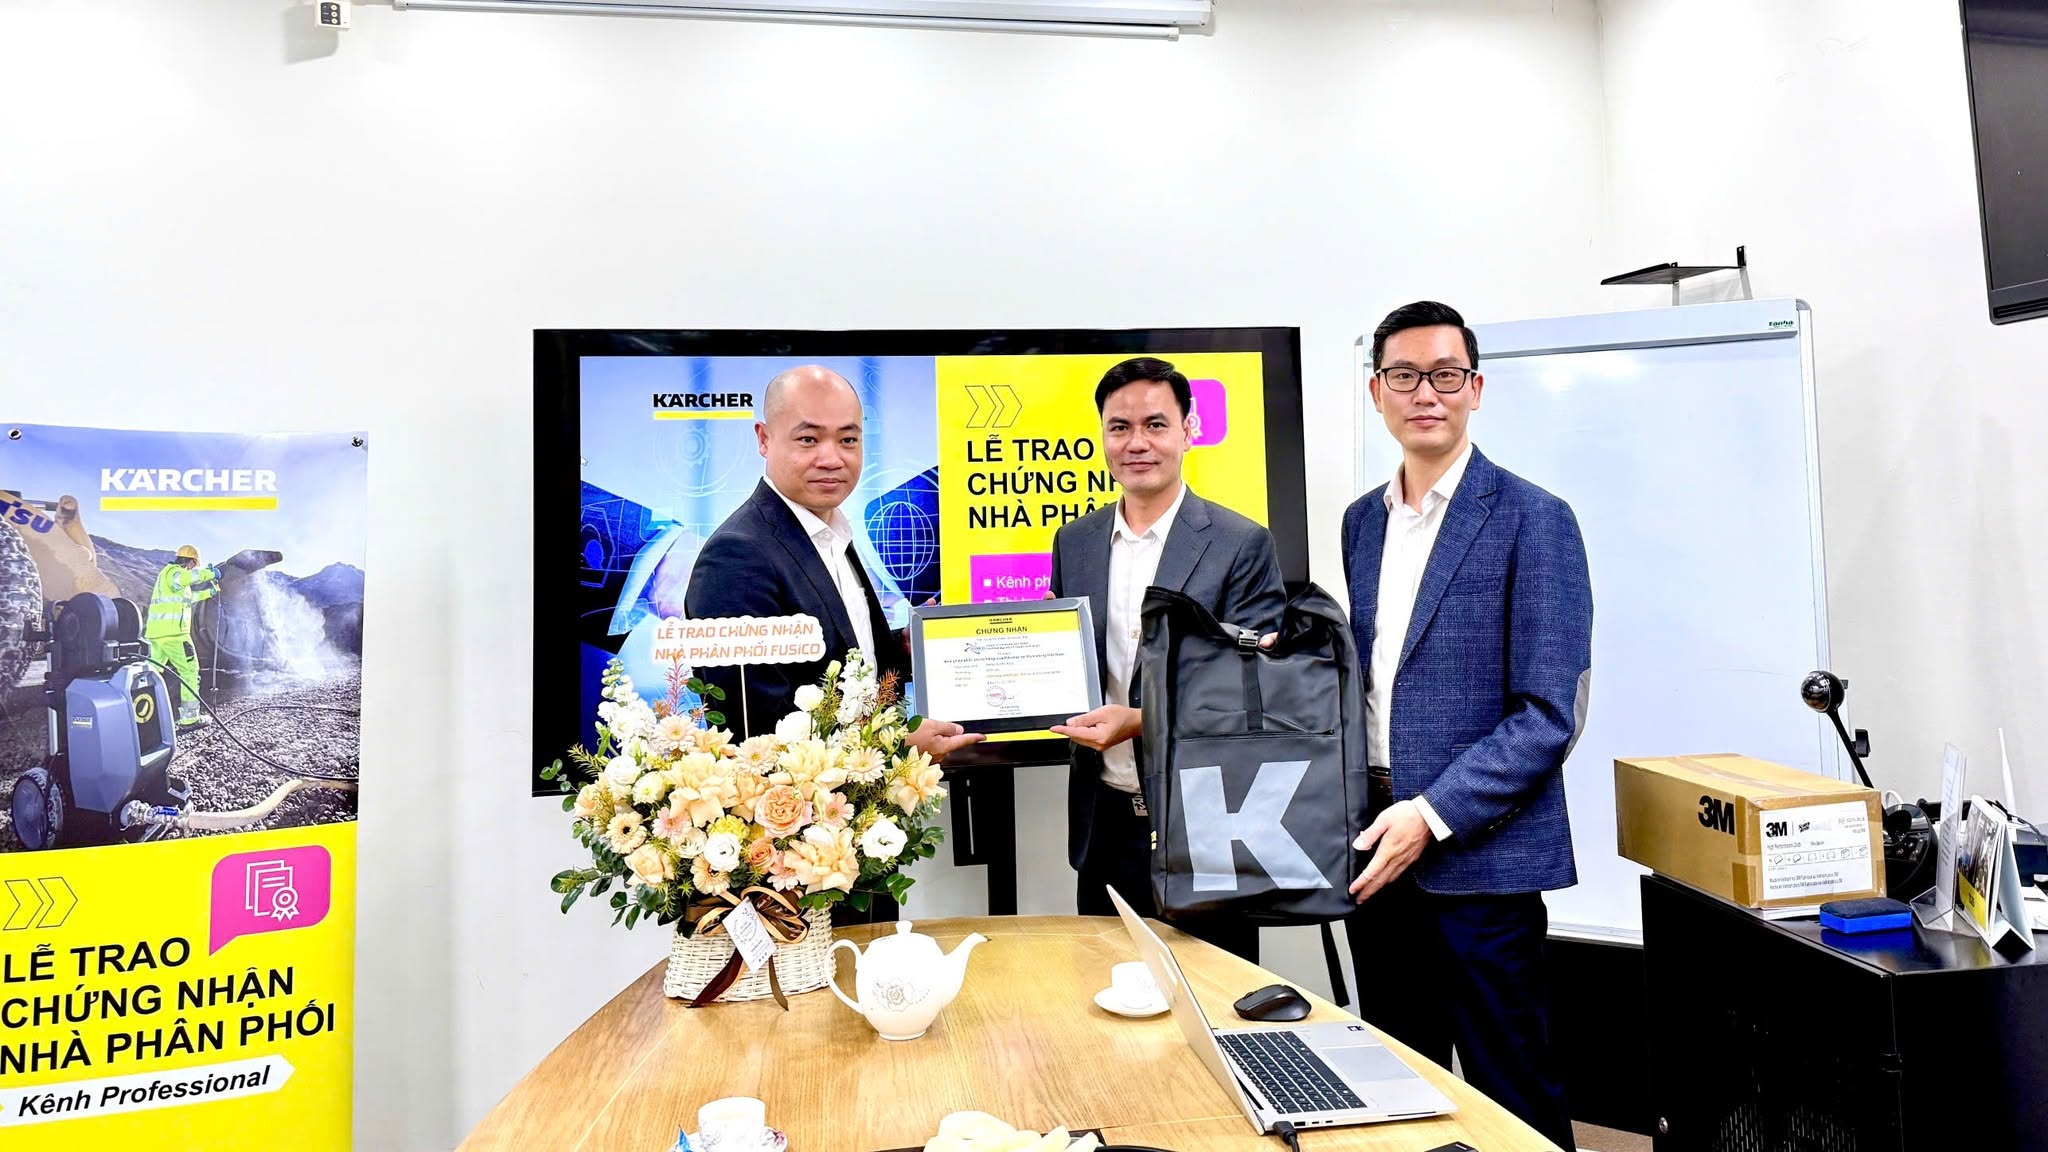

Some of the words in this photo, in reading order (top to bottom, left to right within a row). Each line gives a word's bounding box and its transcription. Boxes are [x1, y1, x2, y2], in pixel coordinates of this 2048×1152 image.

[653, 393, 754, 408] KÄRCHER
[967, 434, 1003, 463] LỄ
[1012, 438, 1095, 462] TRAO
[101, 468, 278, 492] KÄRCHER
[967, 466, 1077, 495] CHỨNG
[1088, 470, 1121, 493] NH
[969, 499, 1032, 529] NHÀ
[1042, 497, 1107, 527] PHÂ
[996, 575, 1031, 588] Kênh
[657, 621, 675, 640] LỄ
[679, 626, 716, 639] TRAO
[719, 621, 768, 638] CHỨNG
[771, 620, 814, 639] NHẬN
[655, 643, 687, 661] NHÀ
[690, 643, 730, 660] PHÂN
[1179, 760, 1333, 892] K
[1697, 795, 1735, 836] 3M
[1766, 821, 1788, 838] 3M
[3, 943, 56, 984] LỄ
[70, 936, 191, 978] TRAO
[1, 983, 162, 1029] CHỨNG
[177, 966, 294, 1010] NHẬN
[0, 1030, 92, 1075] NHÀ
[106, 1018, 224, 1064] PHÂN
[239, 998, 336, 1047] PHỐI
[18, 1090, 91, 1117] Kênh
[100, 1065, 271, 1107] Professional
